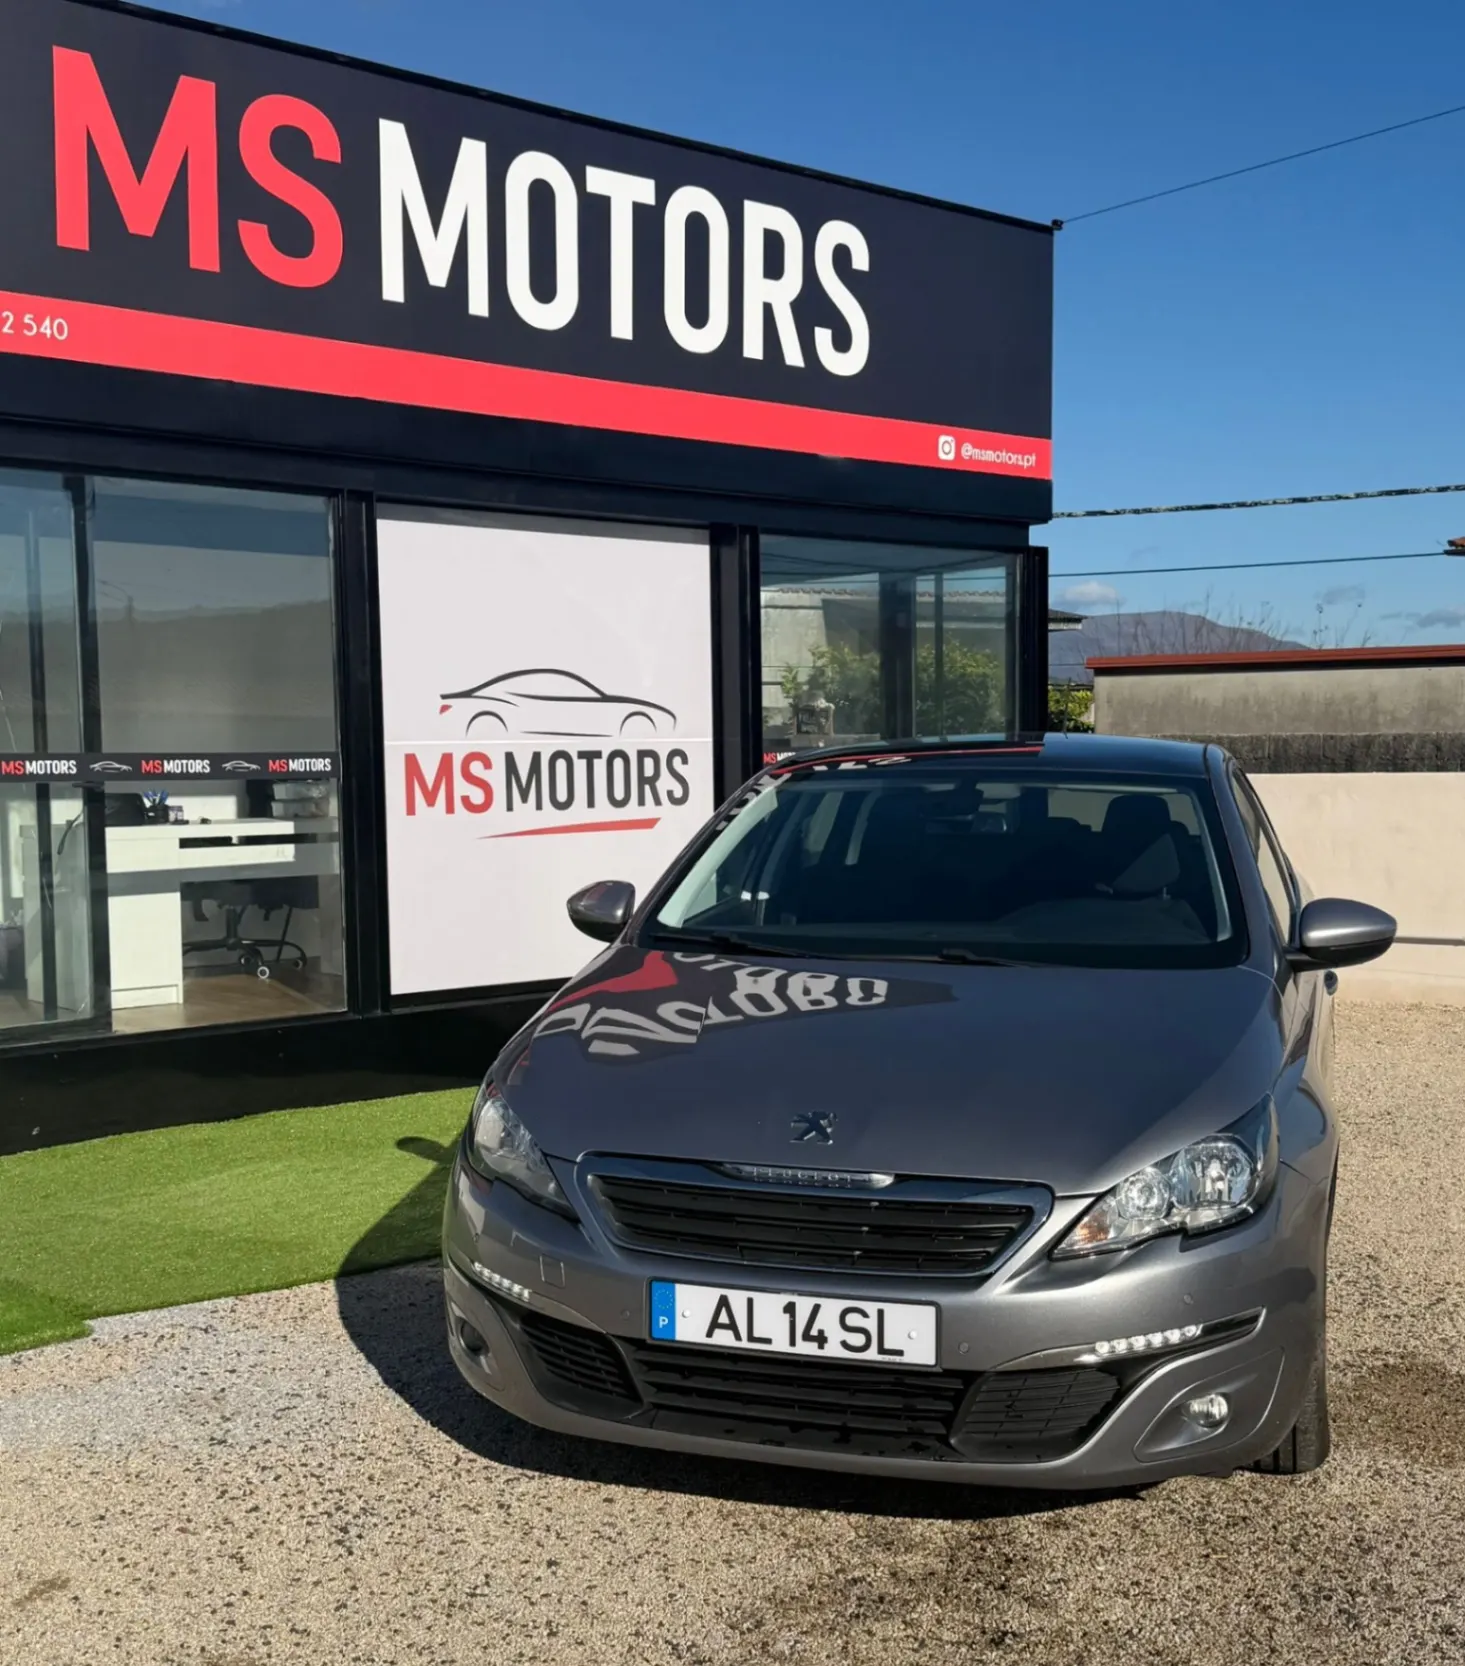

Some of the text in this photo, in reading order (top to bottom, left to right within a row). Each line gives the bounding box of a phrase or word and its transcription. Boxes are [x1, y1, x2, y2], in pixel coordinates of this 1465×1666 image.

[53, 45, 871, 377] MS MOTORS
[1, 310, 69, 341] 2 540
[961, 442, 1036, 469] @msmotors.pt
[1, 759, 77, 775] MS MOTORS
[141, 759, 211, 774] MS MOTORS
[268, 758, 332, 773] MS MOTORS
[404, 748, 690, 816] MS MOTORS
[658, 1316, 669, 1328] P
[705, 1294, 905, 1357] AL 14 SL
